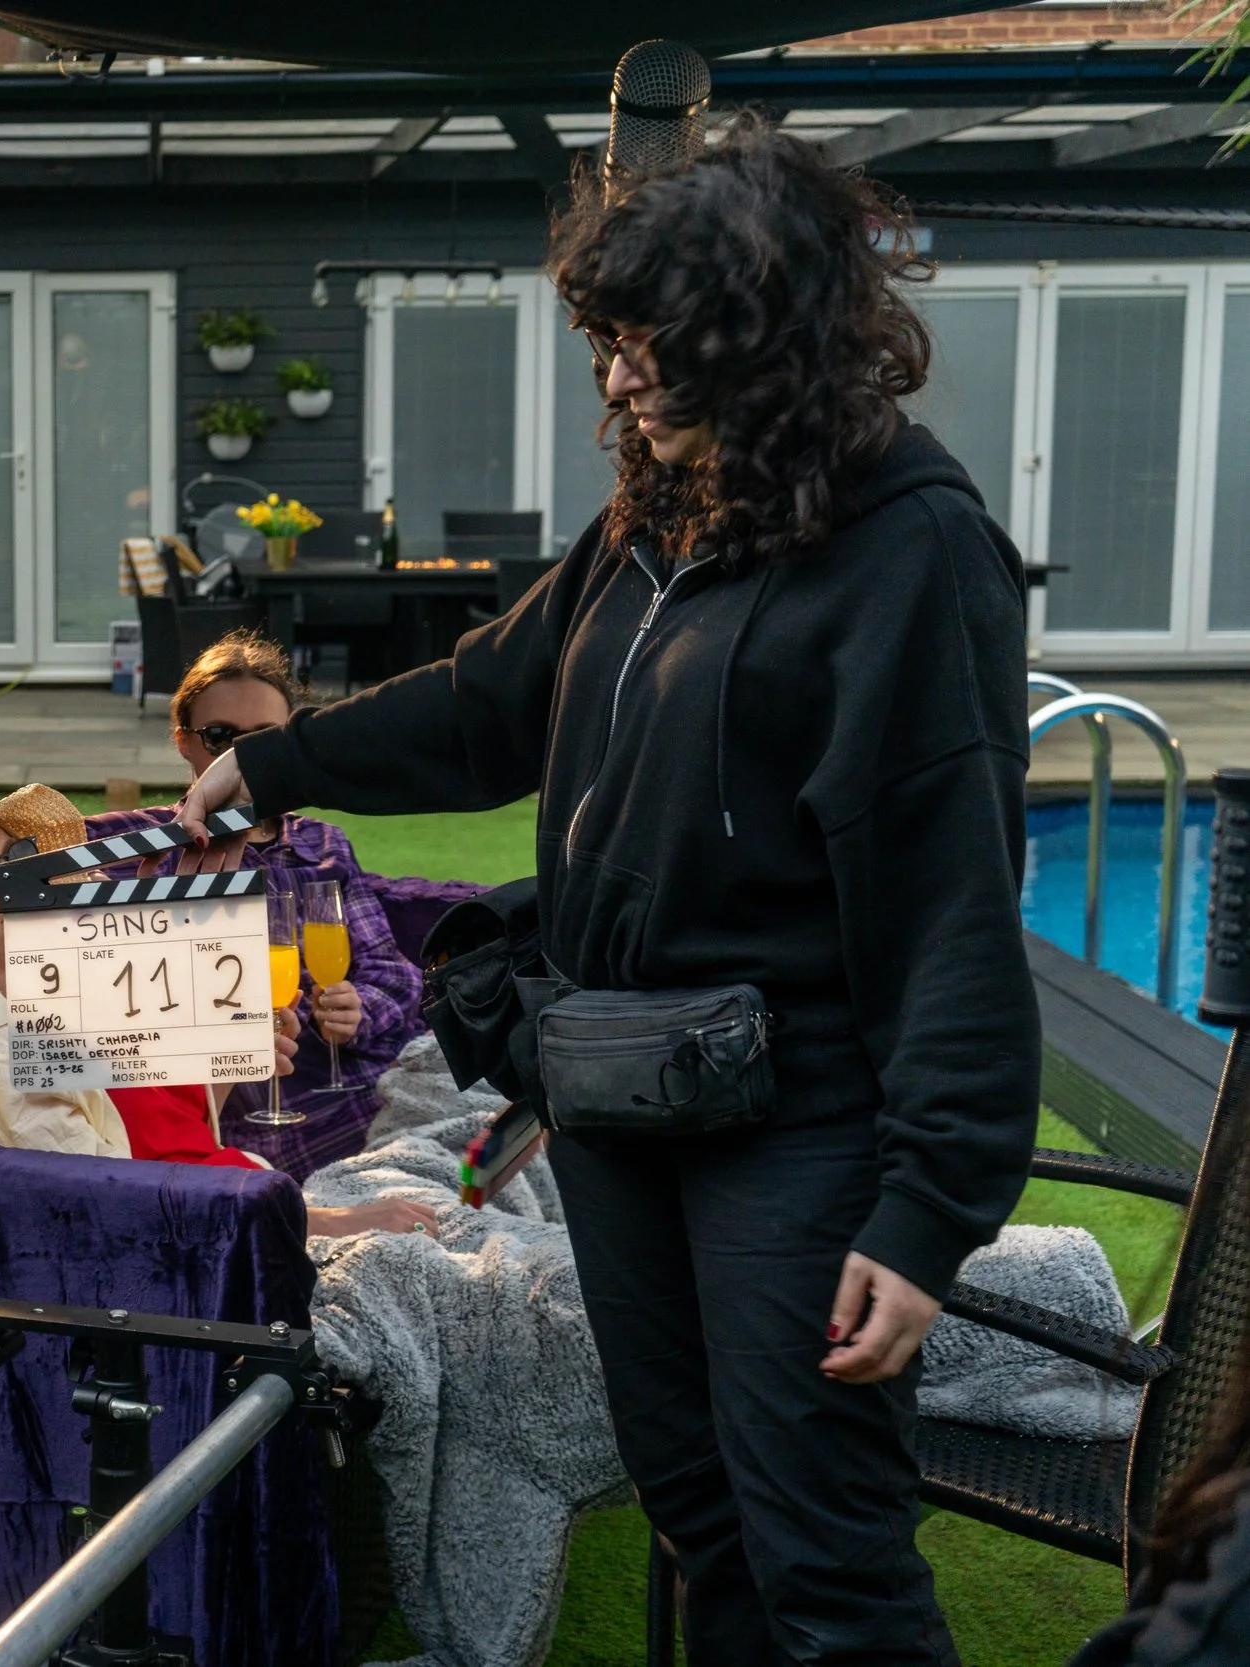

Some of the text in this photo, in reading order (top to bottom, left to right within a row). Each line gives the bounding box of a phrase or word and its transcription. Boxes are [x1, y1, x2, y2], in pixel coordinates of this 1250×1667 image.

[77, 910, 168, 941] SANG
[195, 942, 222, 952] TAKE
[9, 954, 45, 965] SCENE
[82, 949, 115, 960] SLATE
[40, 963, 60, 994] 9
[213, 954, 243, 1008] 2
[112, 957, 179, 1018] 11
[10, 1003, 38, 1013] ROLL
[230, 1011, 269, 1021] ARRI Rental
[12, 1032, 161, 1050] DIR: SRISHTI CHHABRIA
[12, 1050, 39, 1060] DOP:
[41, 1050, 83, 1061] ISABEL
[211, 1054, 253, 1065] INT/EXT
[13, 1065, 42, 1076] DATE:
[112, 1060, 148, 1070] FILTER
[112, 1071, 168, 1083] MOS/SYNC
[211, 1065, 270, 1078] DAY/NIGHT
[13, 1077, 54, 1088] FPS 25
